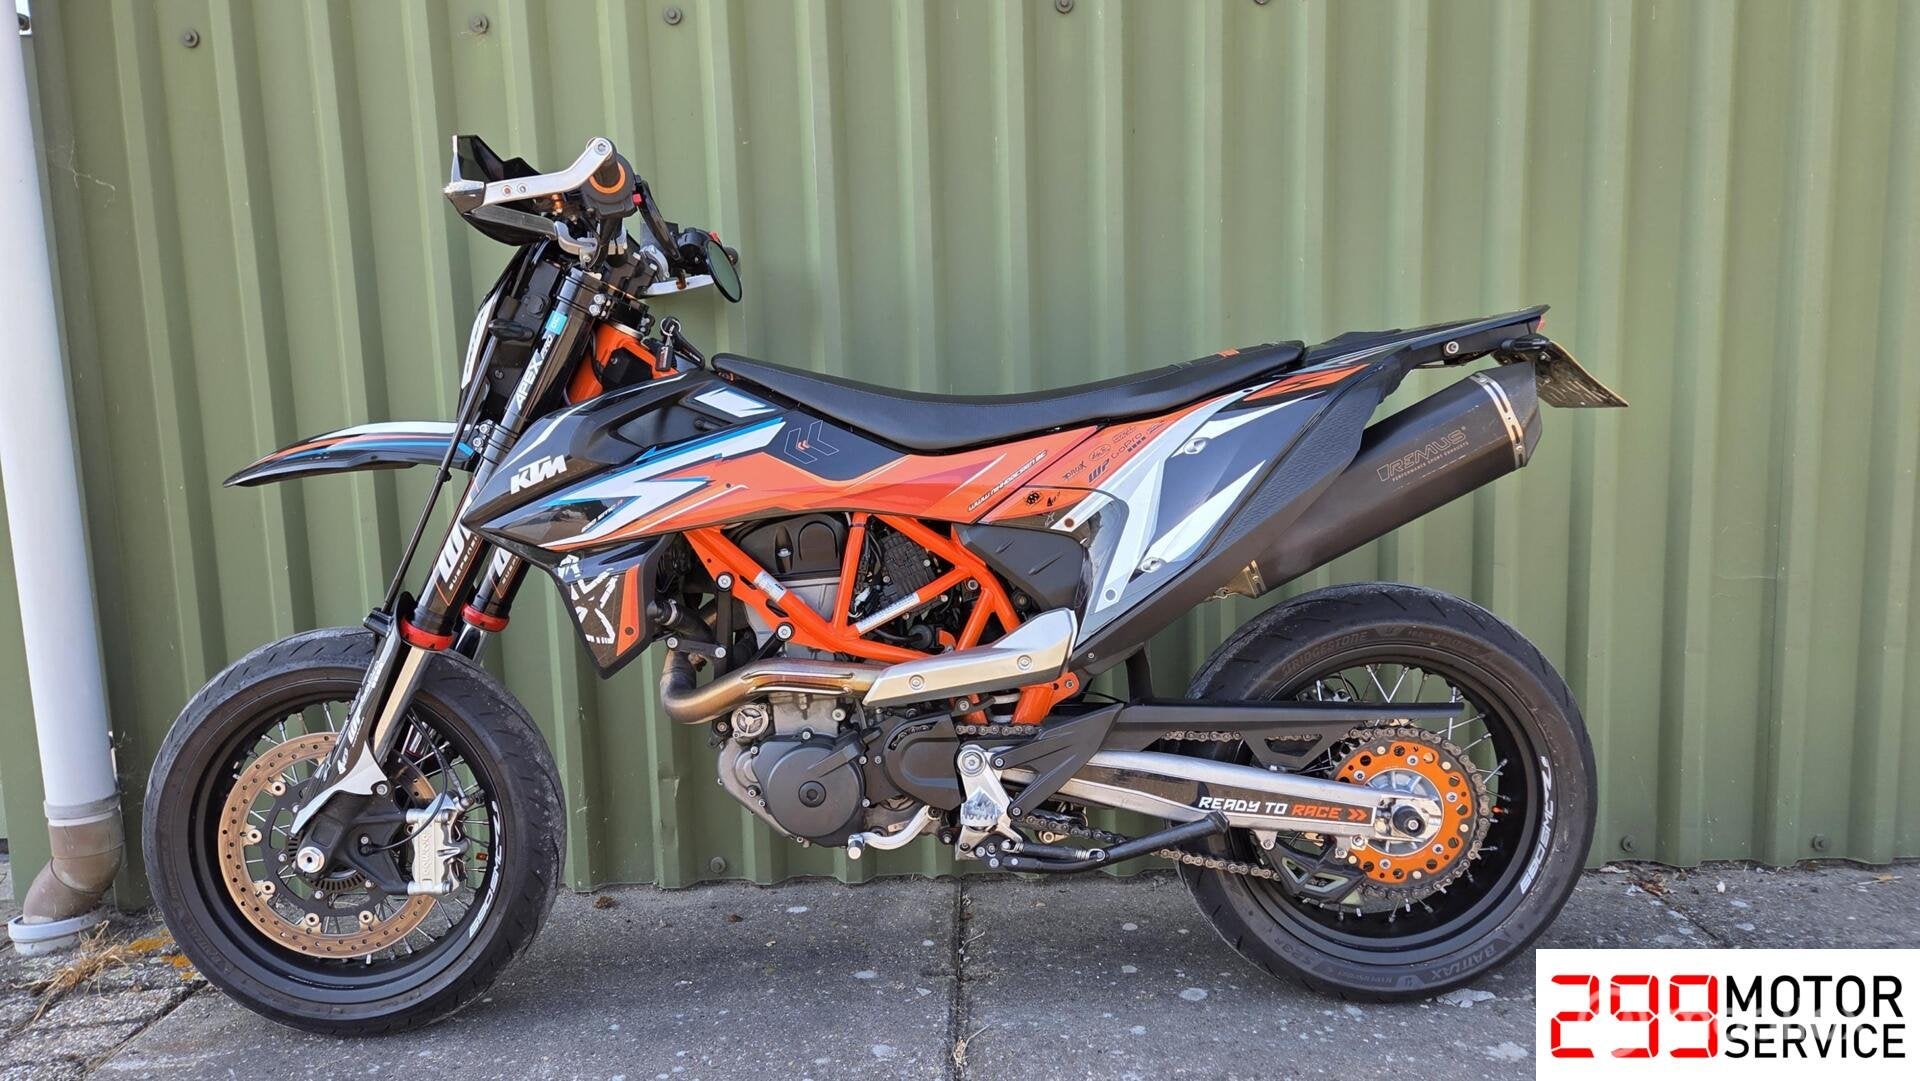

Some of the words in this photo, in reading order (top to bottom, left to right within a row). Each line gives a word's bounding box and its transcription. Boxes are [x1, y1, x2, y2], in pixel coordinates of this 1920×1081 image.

[516, 350, 544, 410] APEX
[511, 454, 568, 496] KTM
[1389, 429, 1467, 477] REMUS
[448, 534, 480, 591] SUSPENSI
[1198, 796, 1261, 814] READY
[1265, 801, 1289, 815] TO
[1291, 803, 1342, 820] RACE
